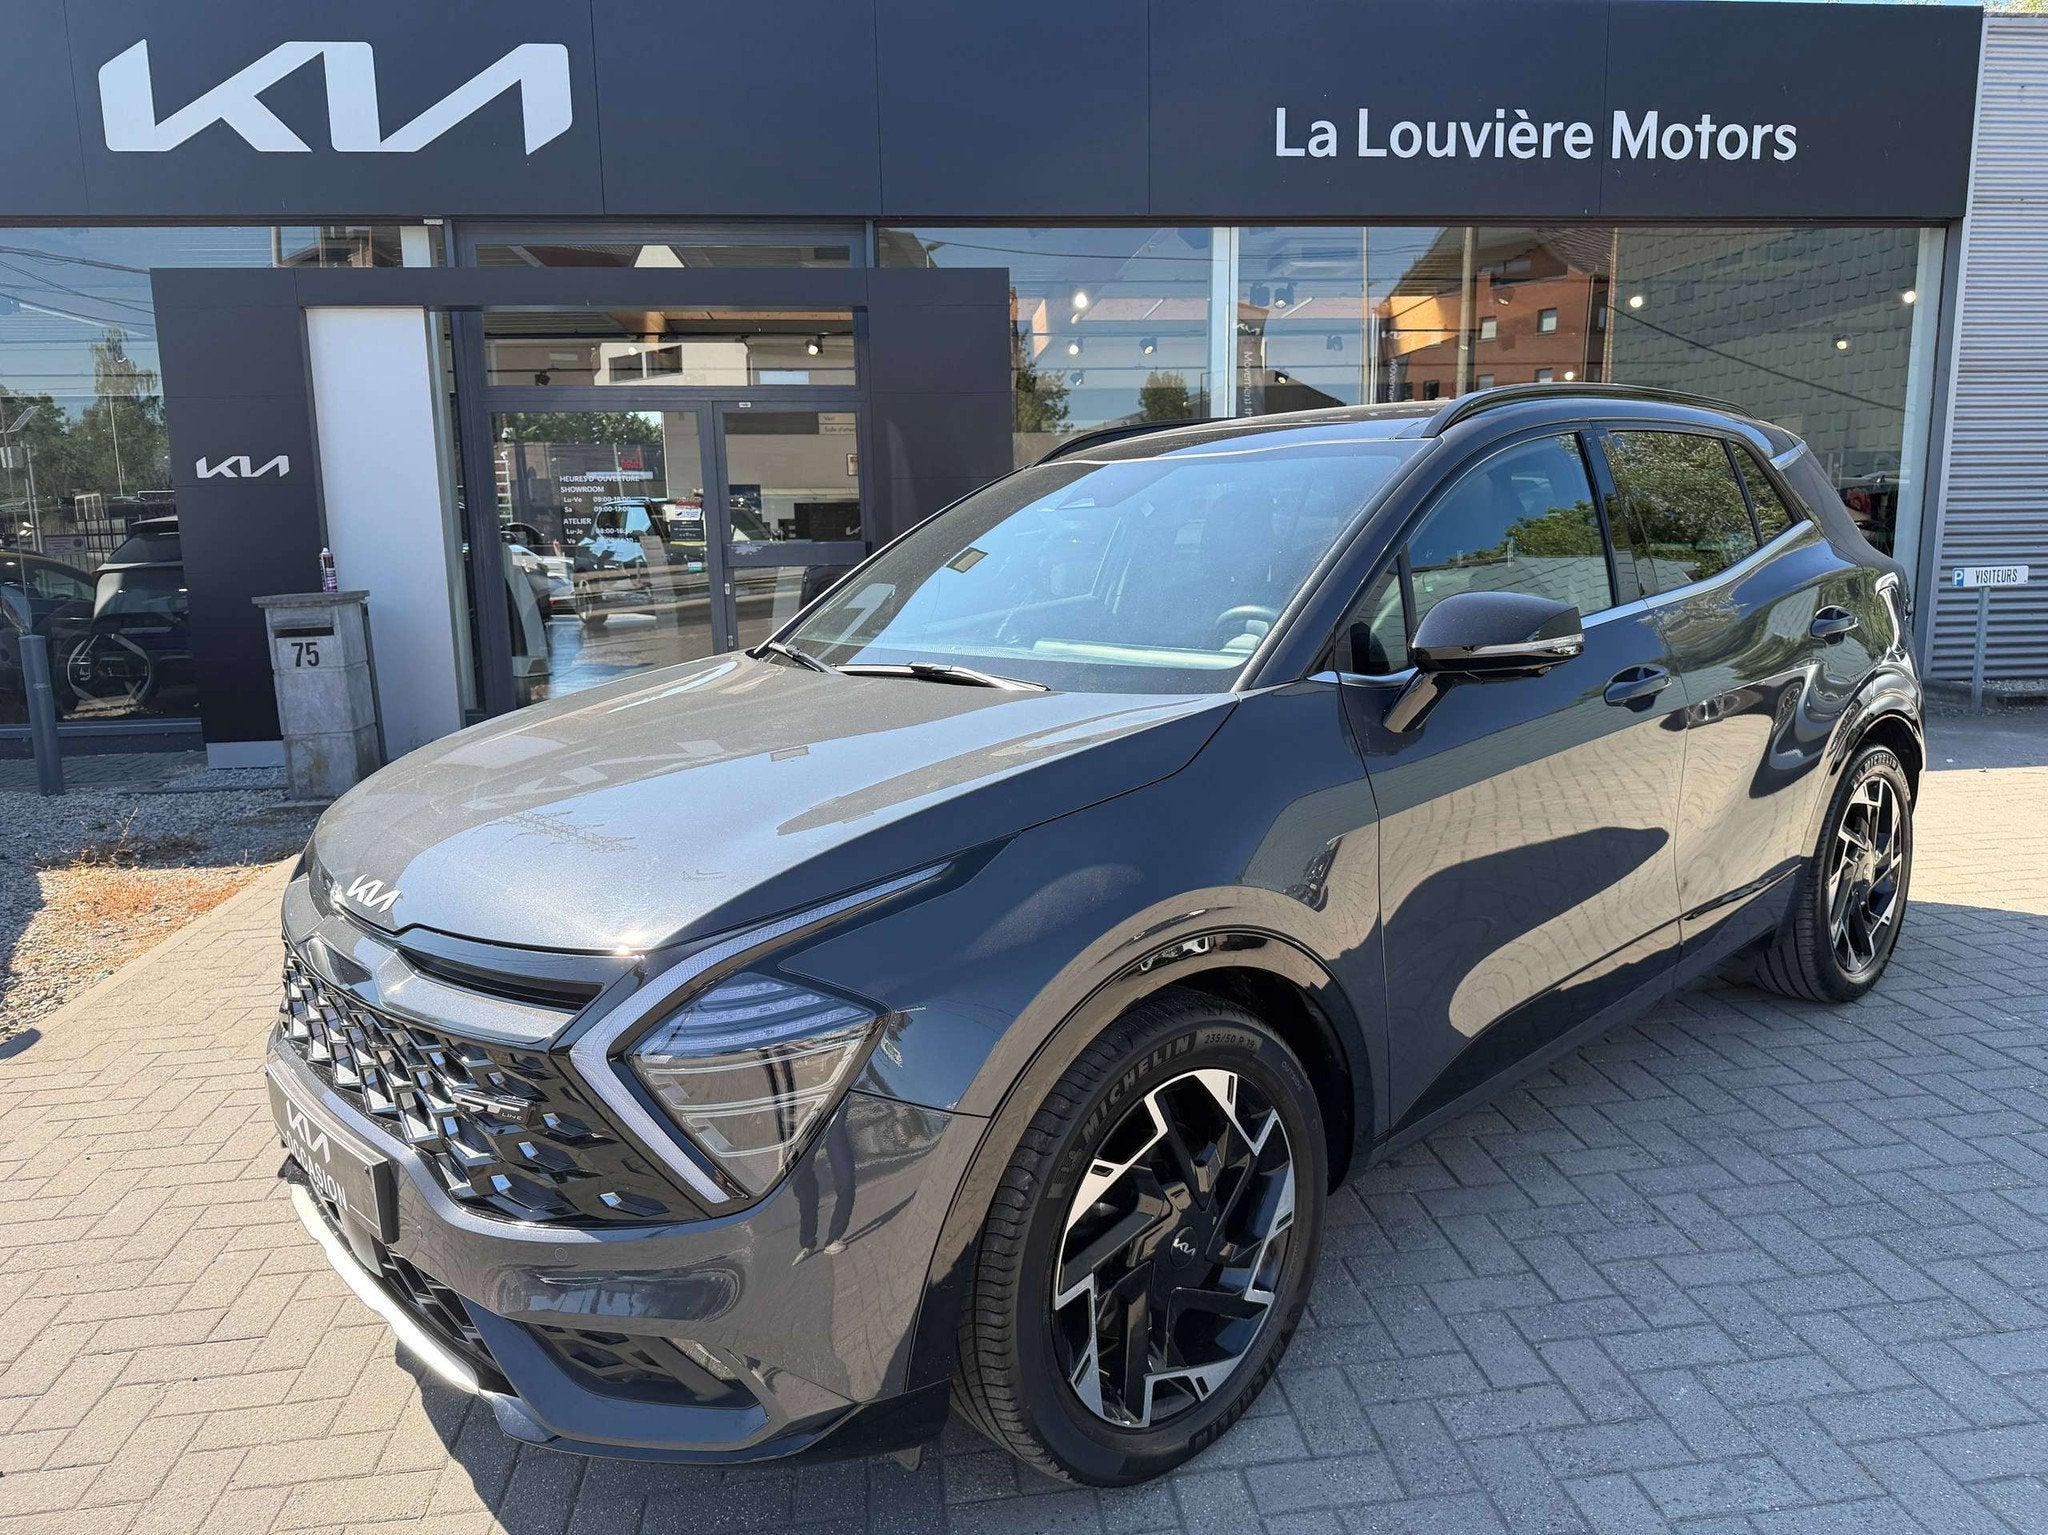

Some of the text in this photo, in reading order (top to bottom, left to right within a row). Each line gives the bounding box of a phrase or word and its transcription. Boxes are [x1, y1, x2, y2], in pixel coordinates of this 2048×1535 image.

[99, 39, 572, 155] KIA
[1275, 107, 1797, 161] La Louvière Motors
[1243, 351, 1253, 404] Movement
[195, 455, 290, 478] KIA
[563, 517, 592, 525] ATELIER
[1975, 568, 2019, 584] VISITEURS
[291, 641, 321, 668] 75
[346, 873, 403, 913] KIA
[1081, 1034, 1191, 1143] MICHELIN
[1204, 1032, 1237, 1045] 235/50
[285, 1098, 331, 1164] KIA
[501, 1111, 523, 1121] LINE
[285, 1130, 349, 1212] OCCASION
[1172, 1237, 1197, 1256] KIA
